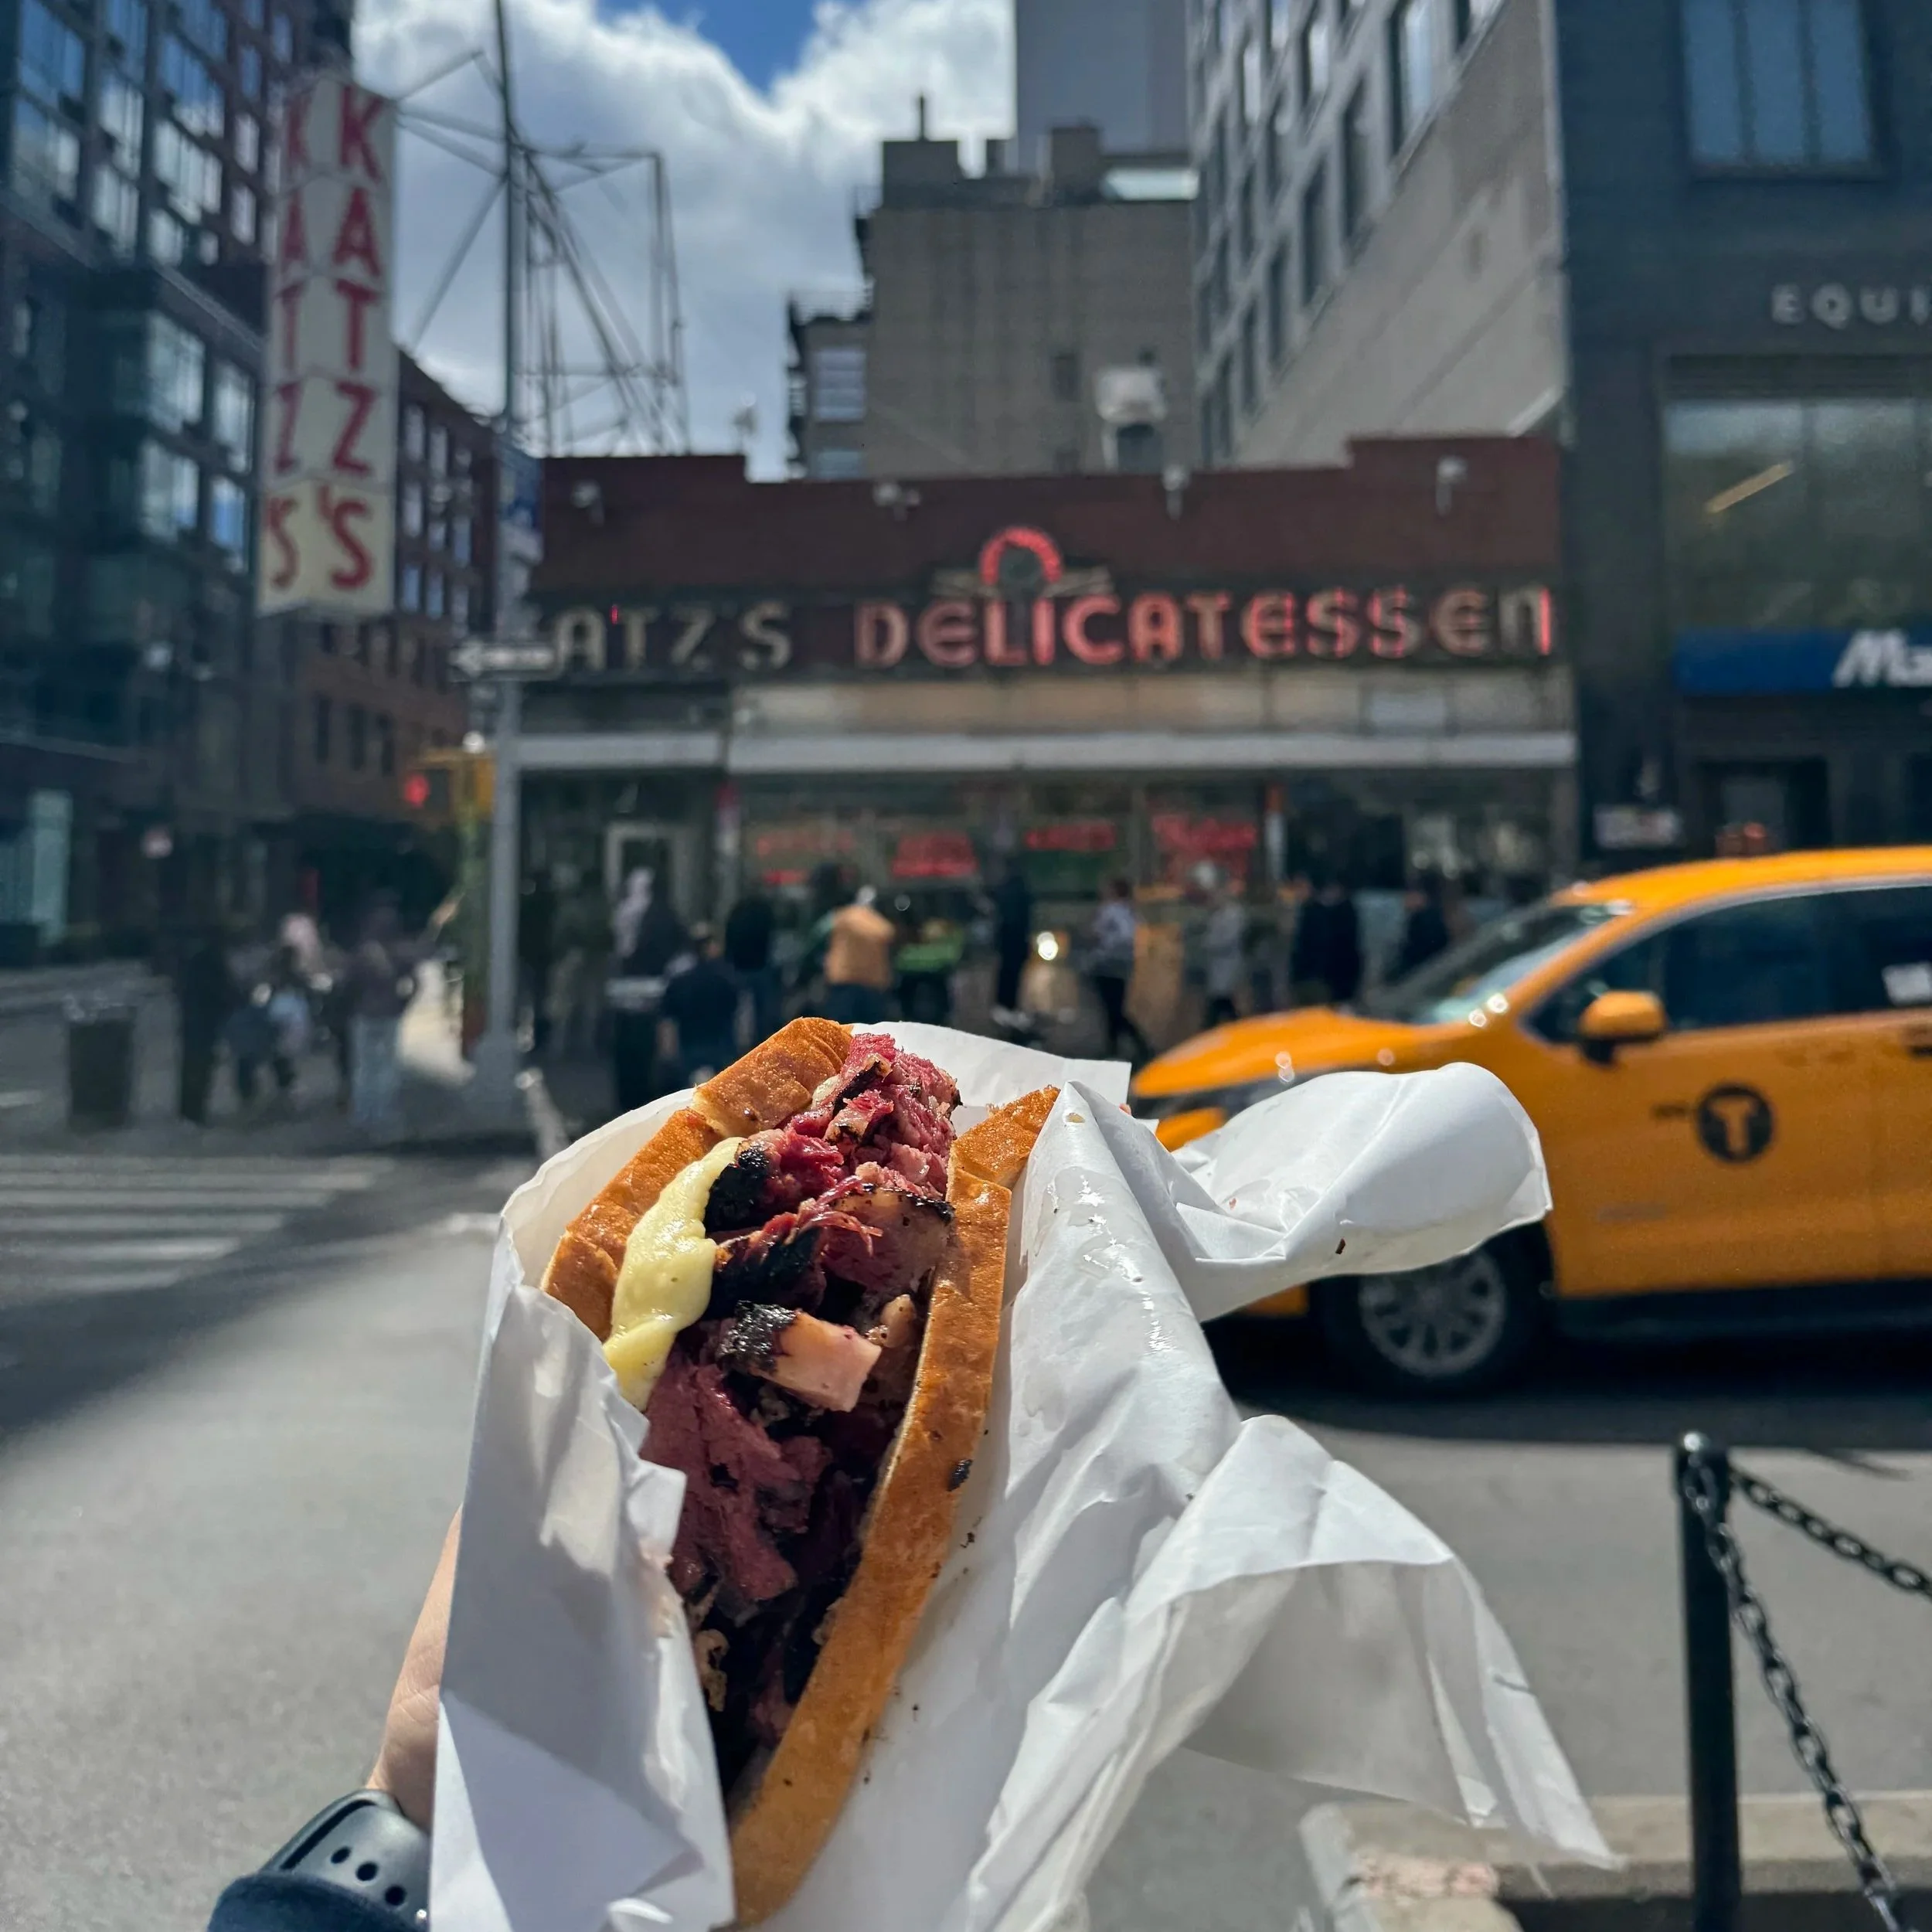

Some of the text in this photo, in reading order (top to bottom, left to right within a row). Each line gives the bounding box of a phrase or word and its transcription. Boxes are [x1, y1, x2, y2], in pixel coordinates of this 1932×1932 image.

[318, 83, 386, 592] KATZ'S
[1772, 283, 1930, 330] EQUI
[551, 600, 793, 671] ATZ'S
[853, 586, 1554, 669] DELICATESSEN
